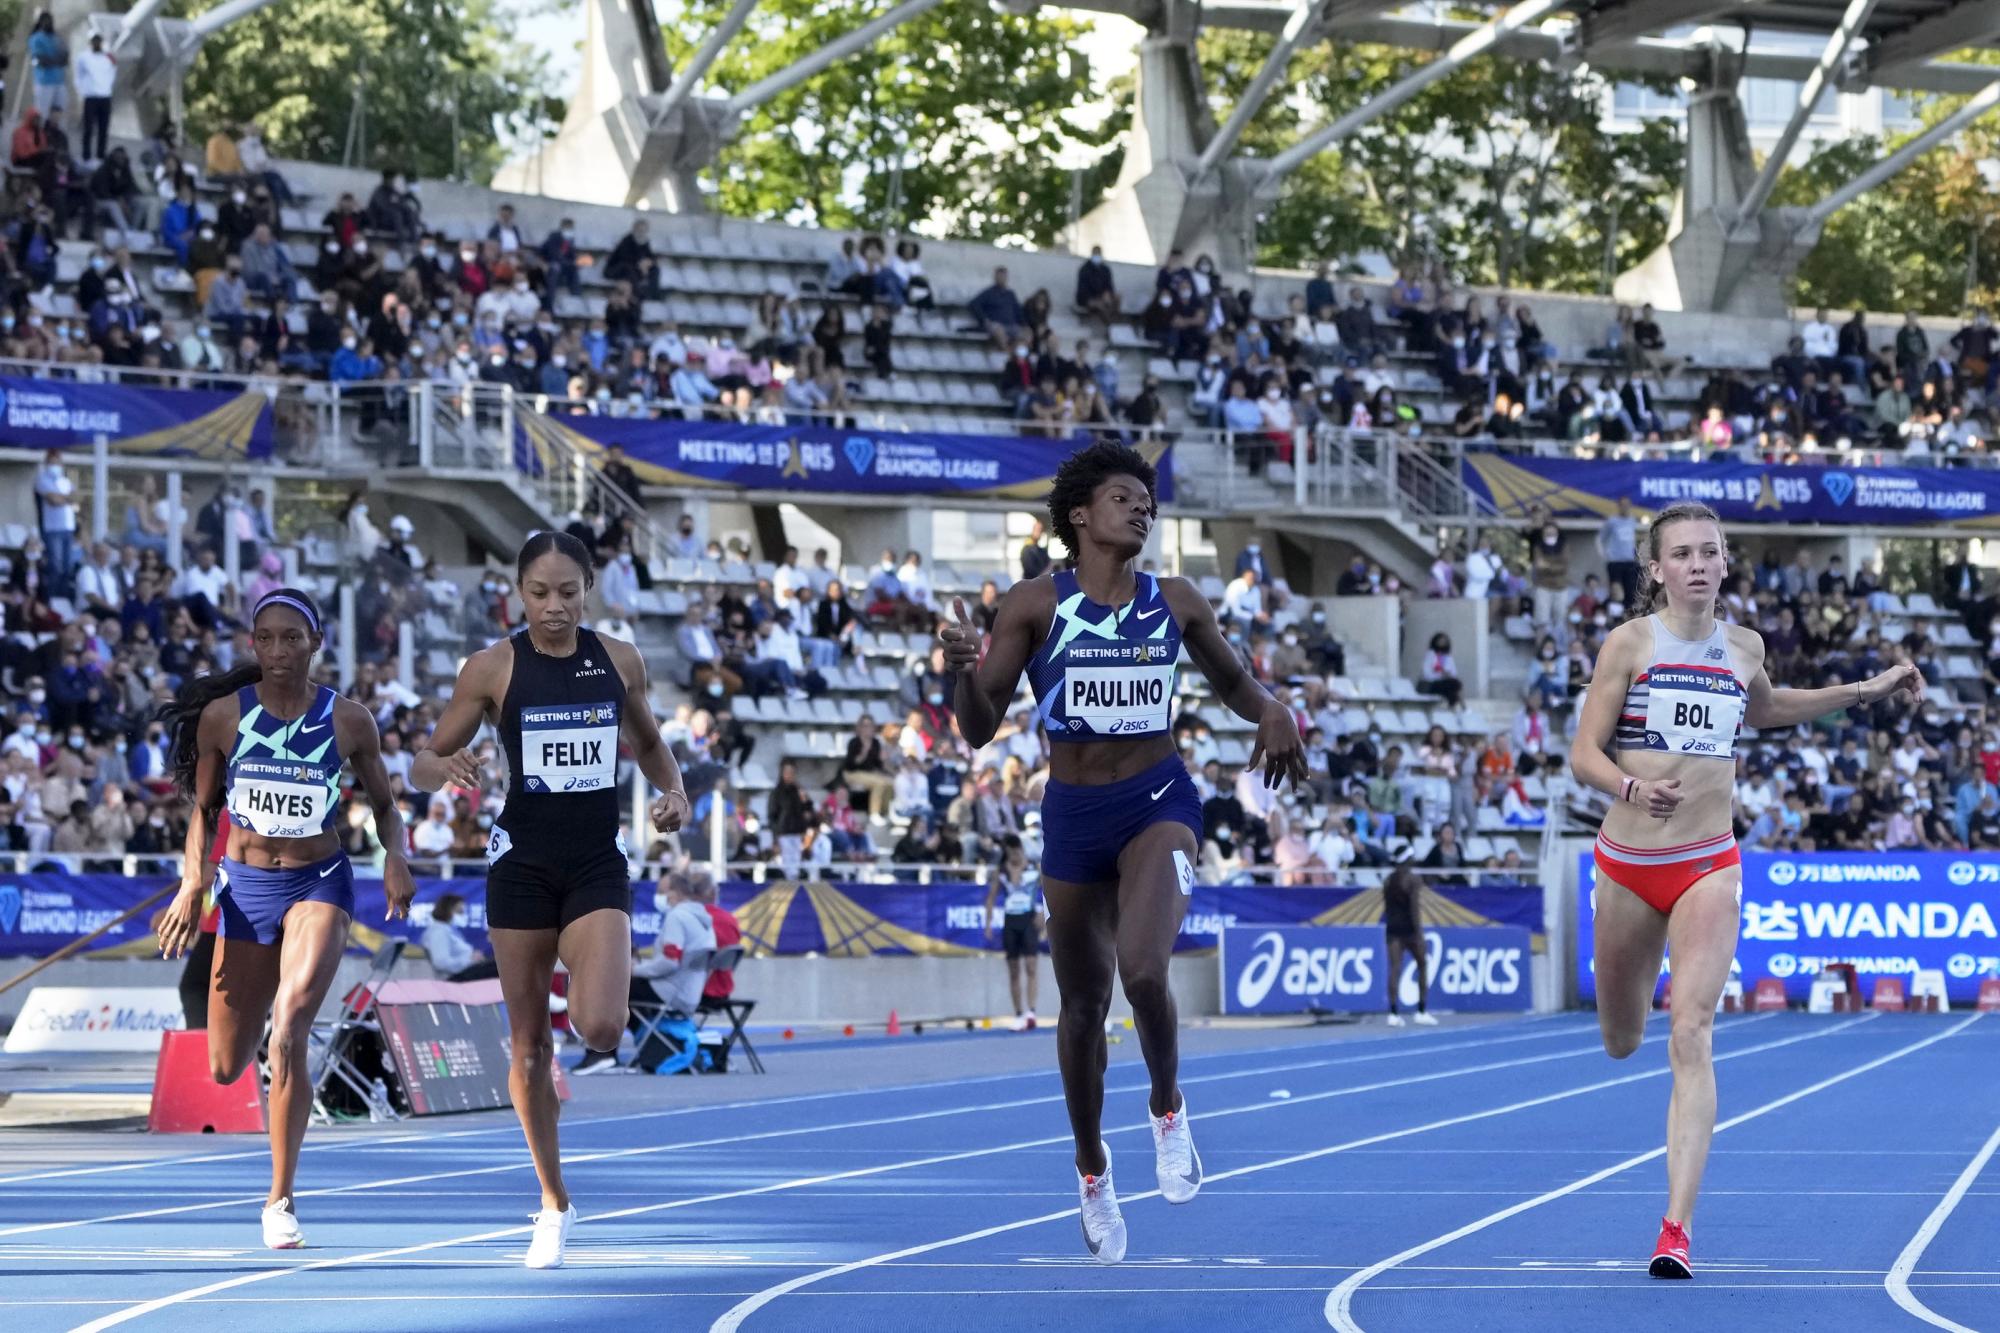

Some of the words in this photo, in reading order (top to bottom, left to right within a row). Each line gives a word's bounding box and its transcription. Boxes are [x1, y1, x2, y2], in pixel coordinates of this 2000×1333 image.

[679, 440, 756, 465] MEETING
[876, 456, 943, 478] DIAMOND
[944, 459, 999, 480] LEAGUE
[1641, 477, 1724, 499] MEETING
[1856, 488, 1926, 508] DIAMOND
[1927, 491, 1986, 510] LEAGUE
[1070, 648, 1119, 658] MEETING
[1121, 648, 1131, 657] DE
[1132, 645, 1168, 661] PARIS
[575, 668, 606, 678] ATHLETA
[1651, 673, 1695, 683] MEETING
[1705, 677, 1736, 691] PARIS
[1073, 678, 1163, 707] PAULINO
[525, 711, 571, 722] MEETING
[572, 711, 582, 720] DE
[583, 707, 614, 724] PARIS
[1674, 702, 1714, 730] BOL
[542, 740, 602, 767] FELIX
[240, 763, 281, 774] MEETING
[283, 767, 292, 775] DE
[293, 765, 325, 781] PARIS
[248, 788, 313, 818] HAYES
[492, 833, 500, 852] 6
[1282, 947, 1375, 996] asics
[1440, 948, 1521, 995] asics
